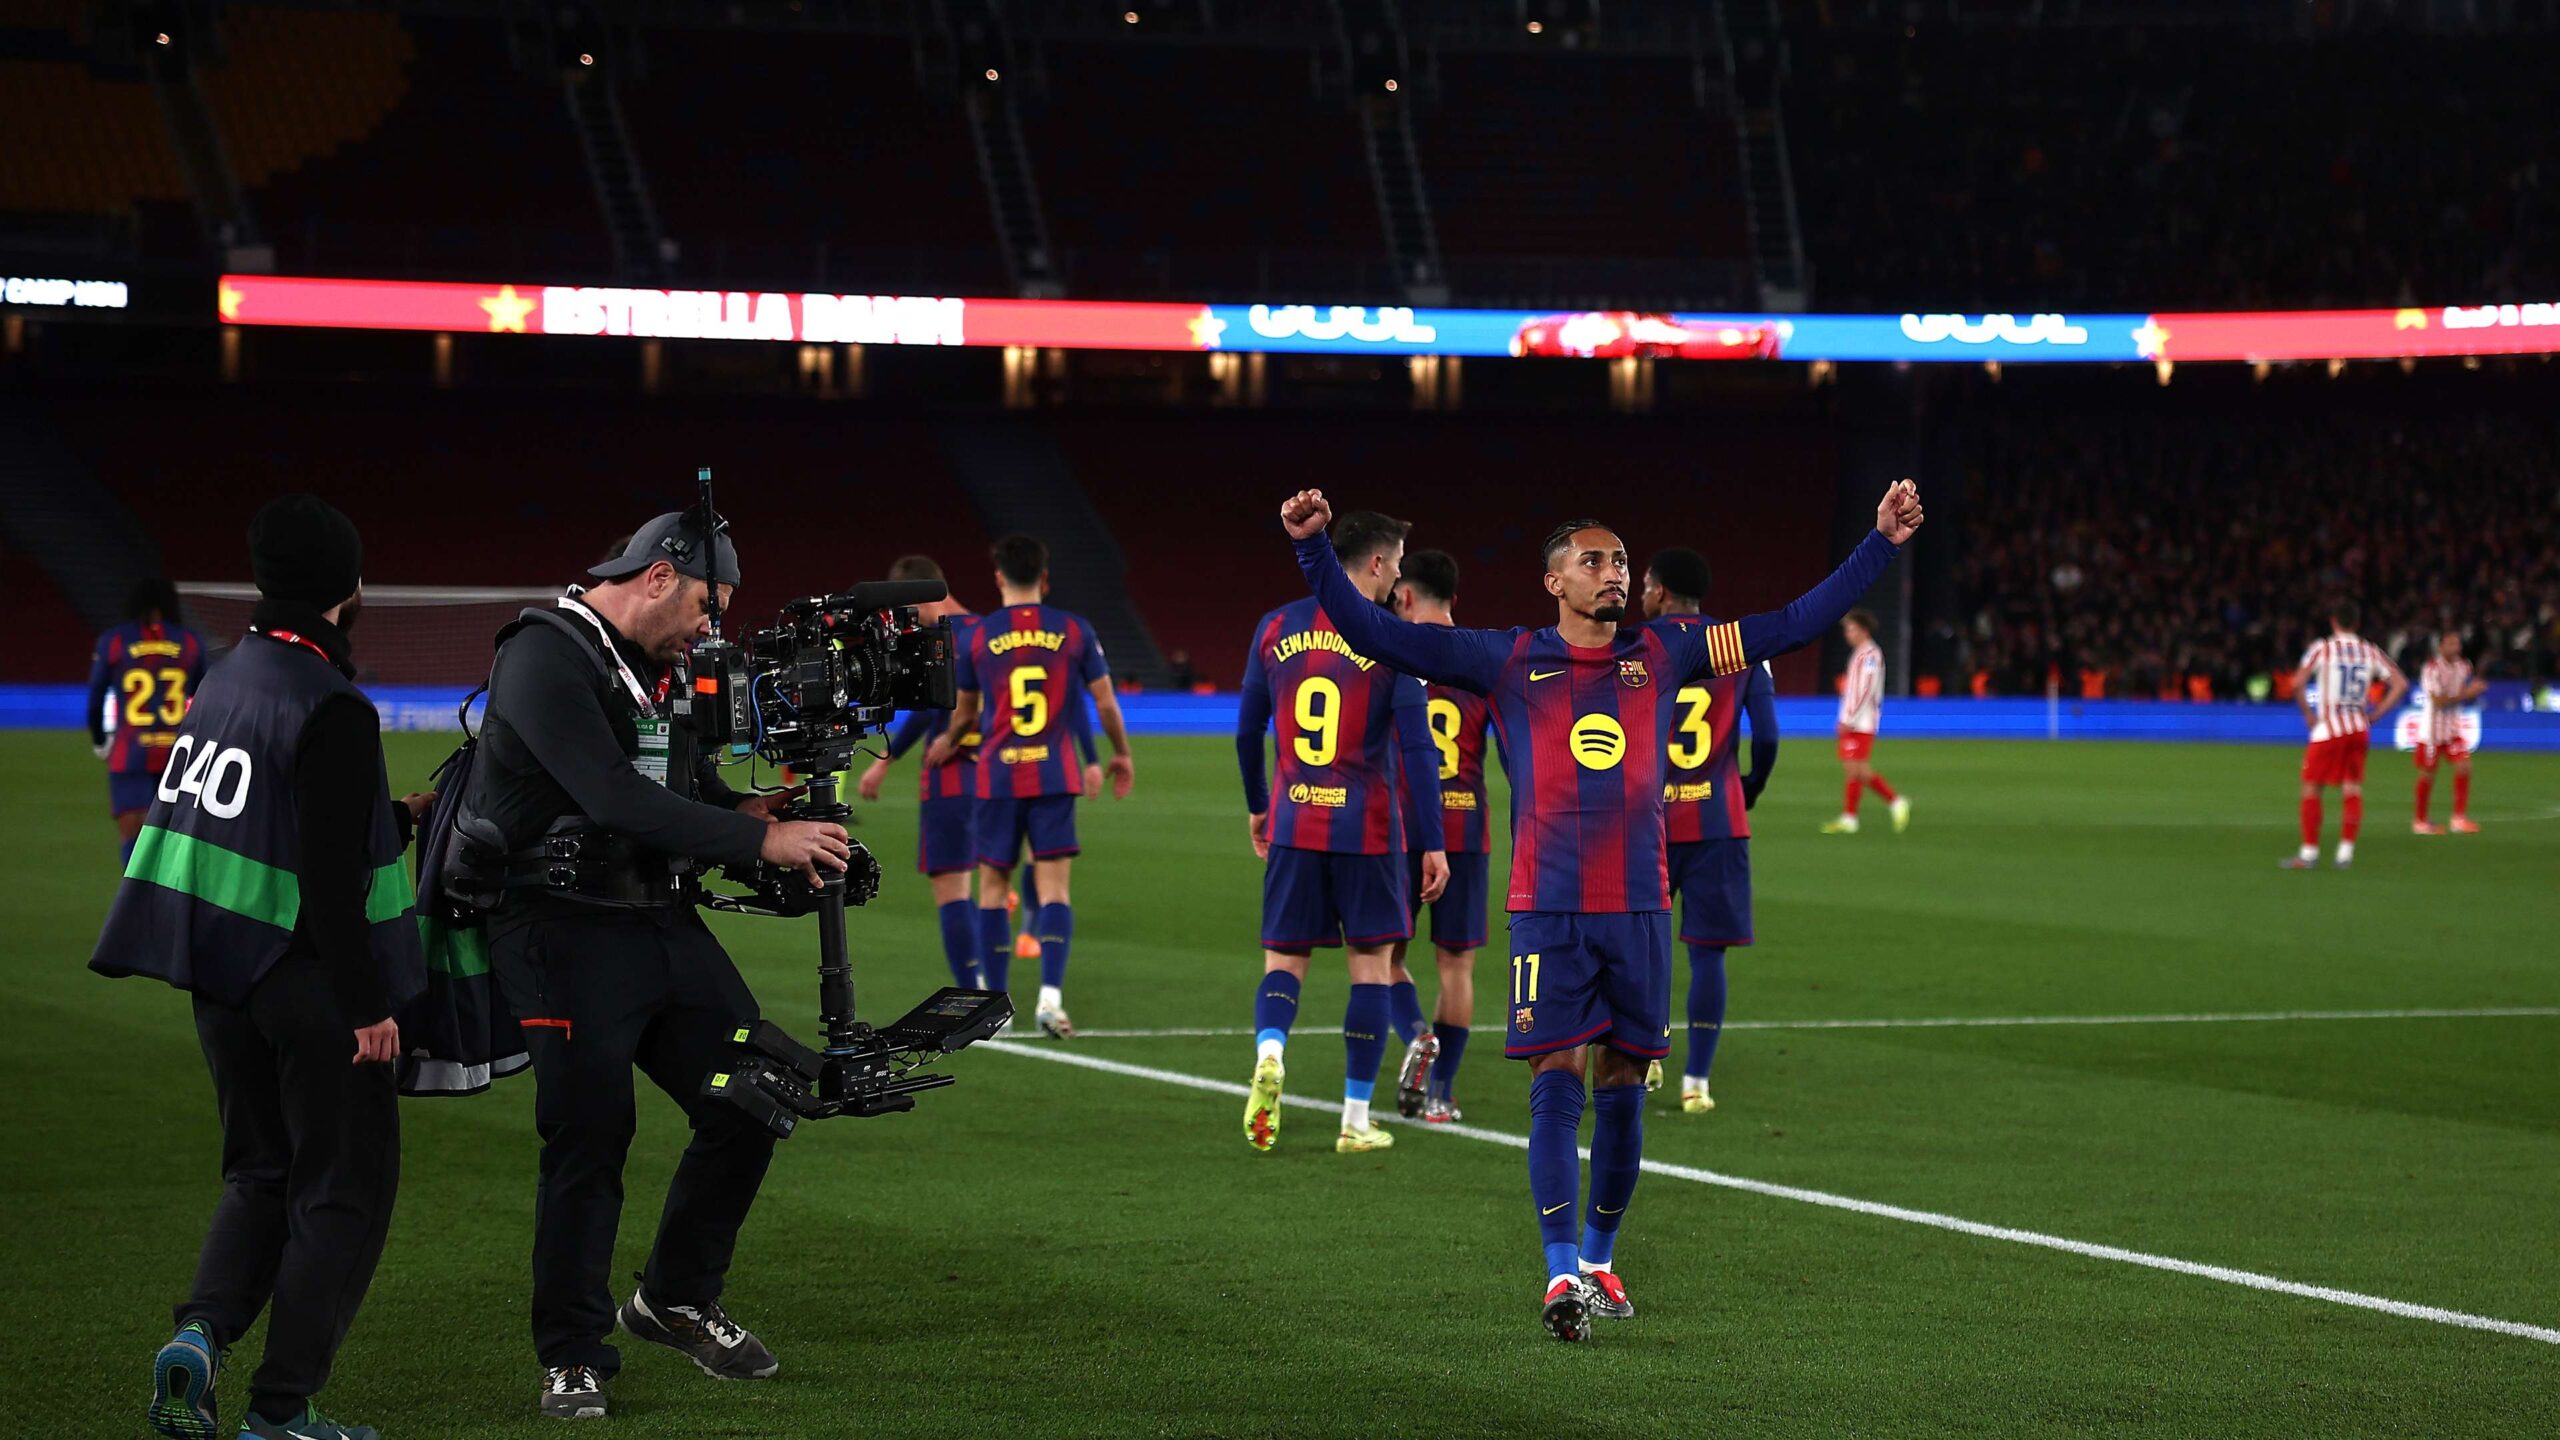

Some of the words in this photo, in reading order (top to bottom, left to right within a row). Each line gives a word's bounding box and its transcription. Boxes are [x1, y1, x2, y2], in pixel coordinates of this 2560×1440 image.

[542, 286, 793, 340] ESTRELLA
[121, 667, 189, 727] 23
[1009, 664, 1049, 737] 5
[2338, 664, 2366, 700] 15
[1293, 676, 1342, 768] 9
[1427, 698, 1462, 781] 8
[1667, 686, 1713, 771] 3
[157, 734, 253, 820] 040
[1512, 953, 1541, 1005] 11
